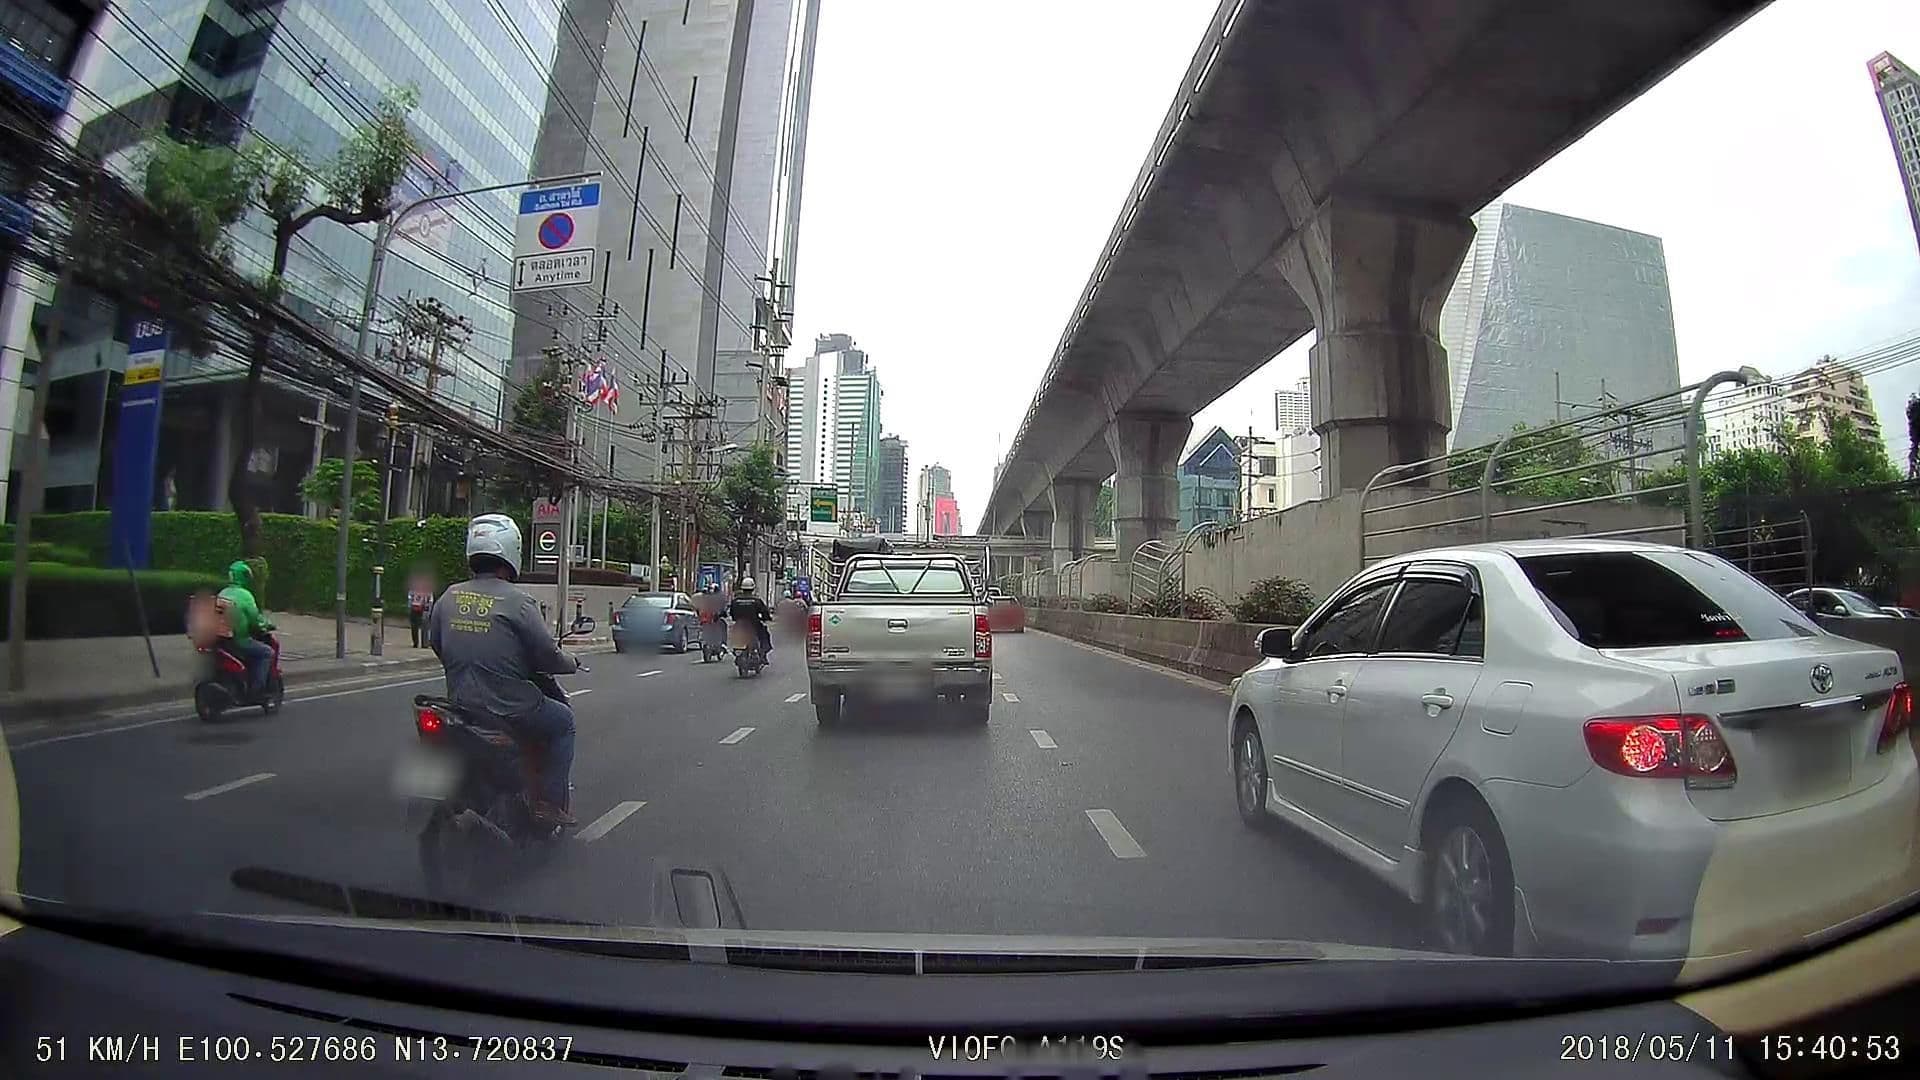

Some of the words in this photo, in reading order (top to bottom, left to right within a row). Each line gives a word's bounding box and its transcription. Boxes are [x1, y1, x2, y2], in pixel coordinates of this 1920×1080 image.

[530, 255, 588, 271] ตลอดเวลา
[535, 270, 581, 283] Anytime
